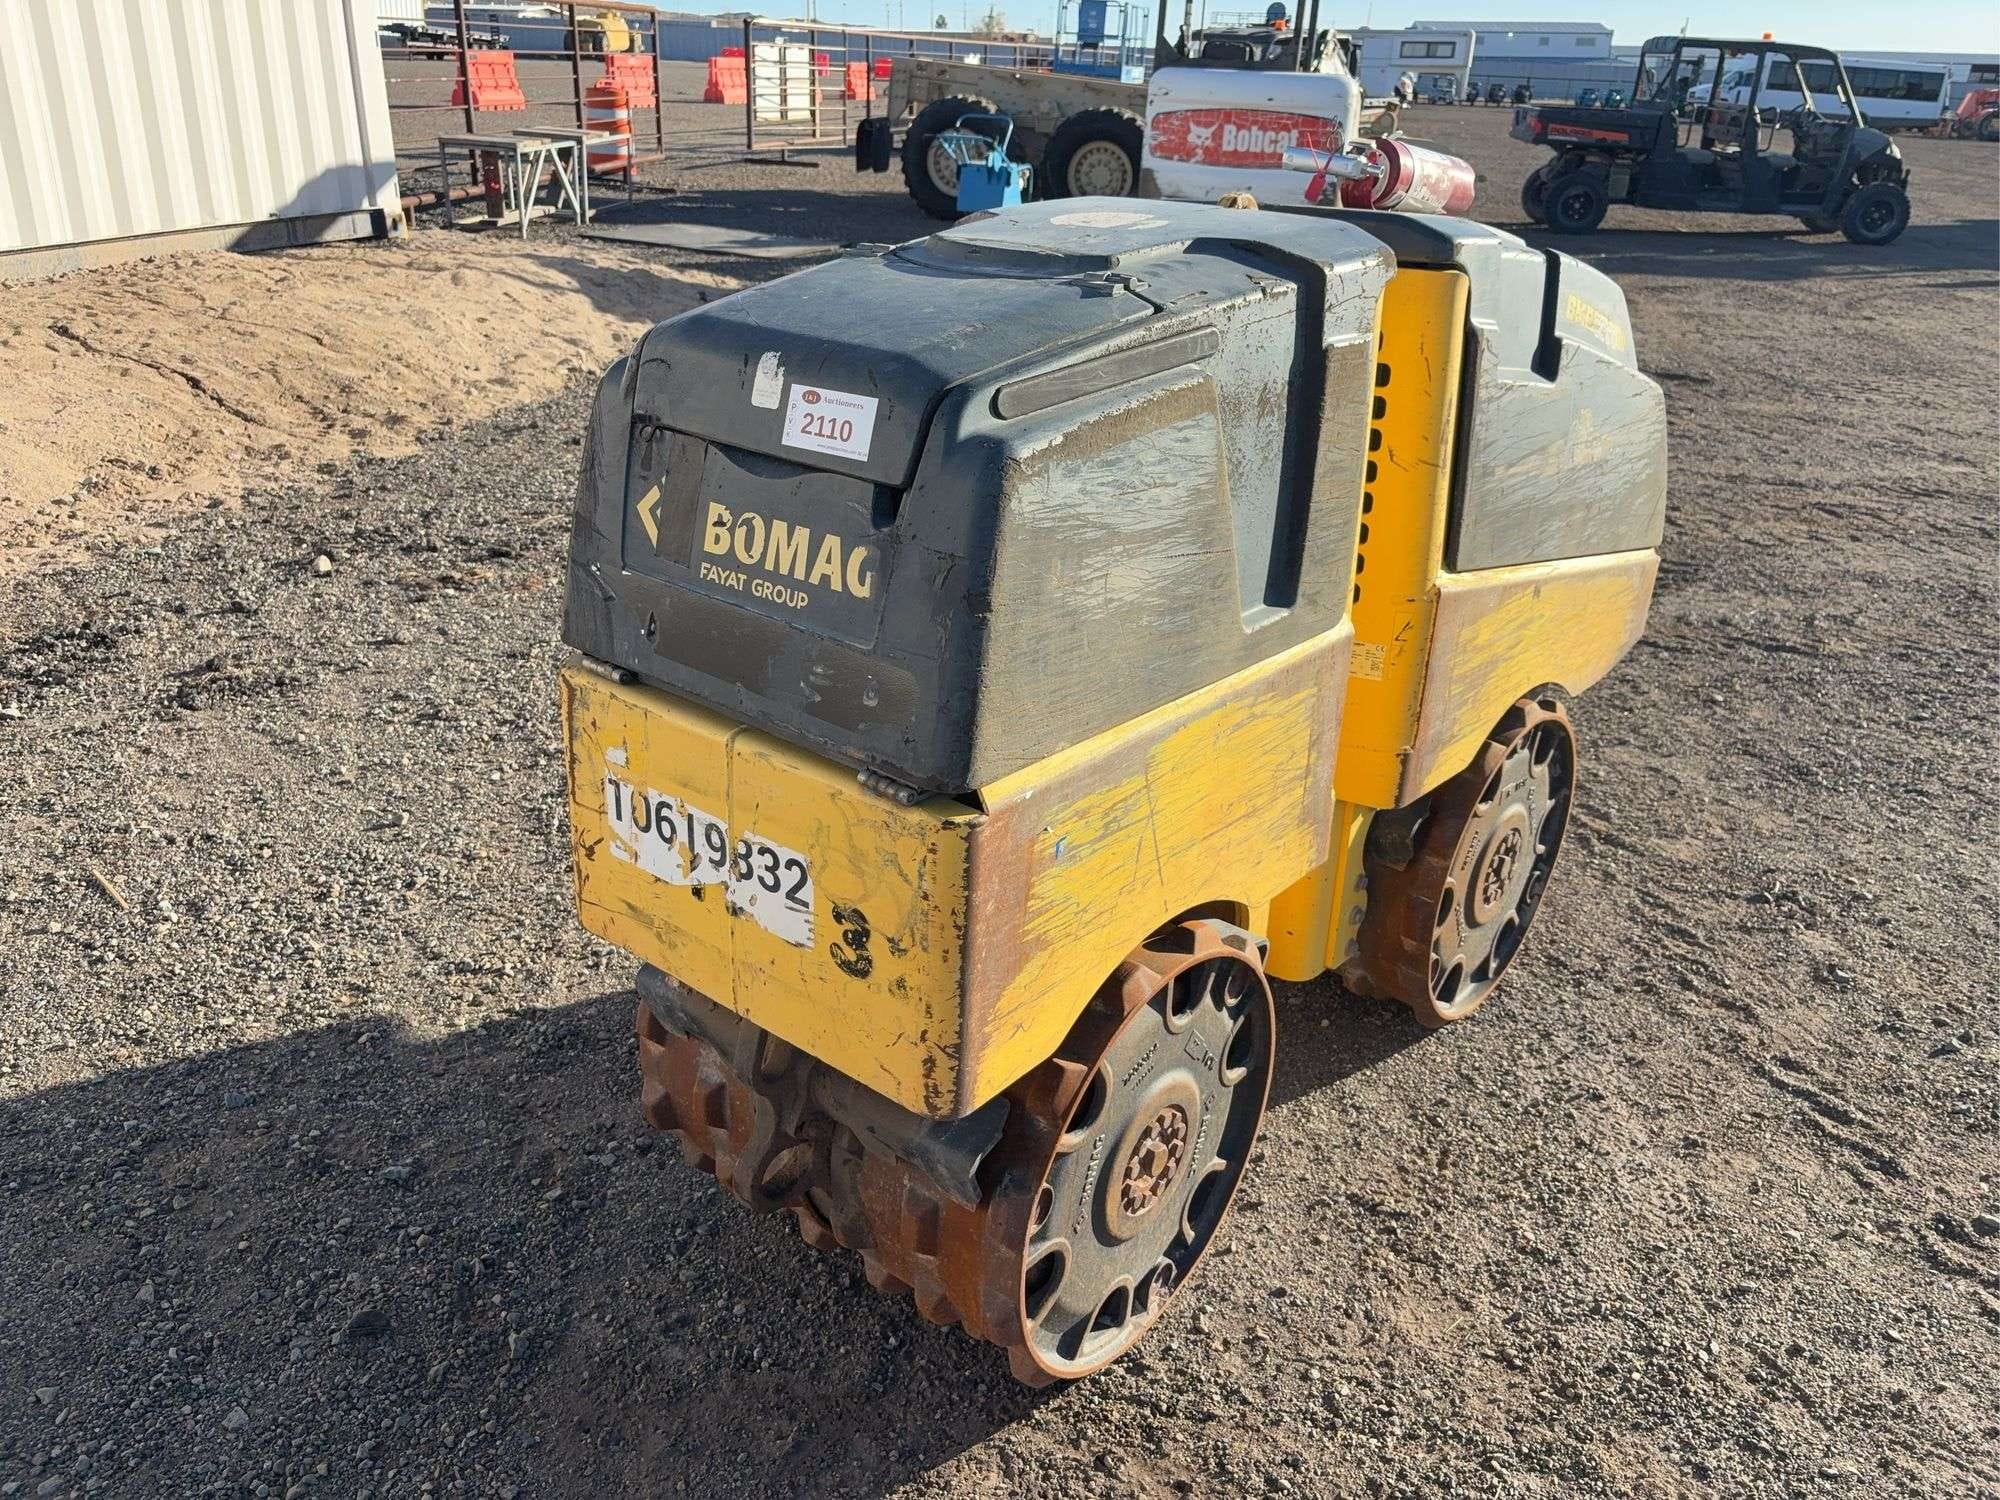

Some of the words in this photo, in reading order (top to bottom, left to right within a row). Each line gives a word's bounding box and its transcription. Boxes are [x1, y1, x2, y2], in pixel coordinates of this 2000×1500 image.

[1222, 124, 1299, 153] Bobcat
[824, 397, 864, 410] Auctioneers
[800, 412, 853, 442] 2110
[703, 501, 872, 599] BOMAG
[699, 561, 747, 591] FAYAT
[751, 578, 809, 609] GROUP
[829, 902, 873, 979] 3
